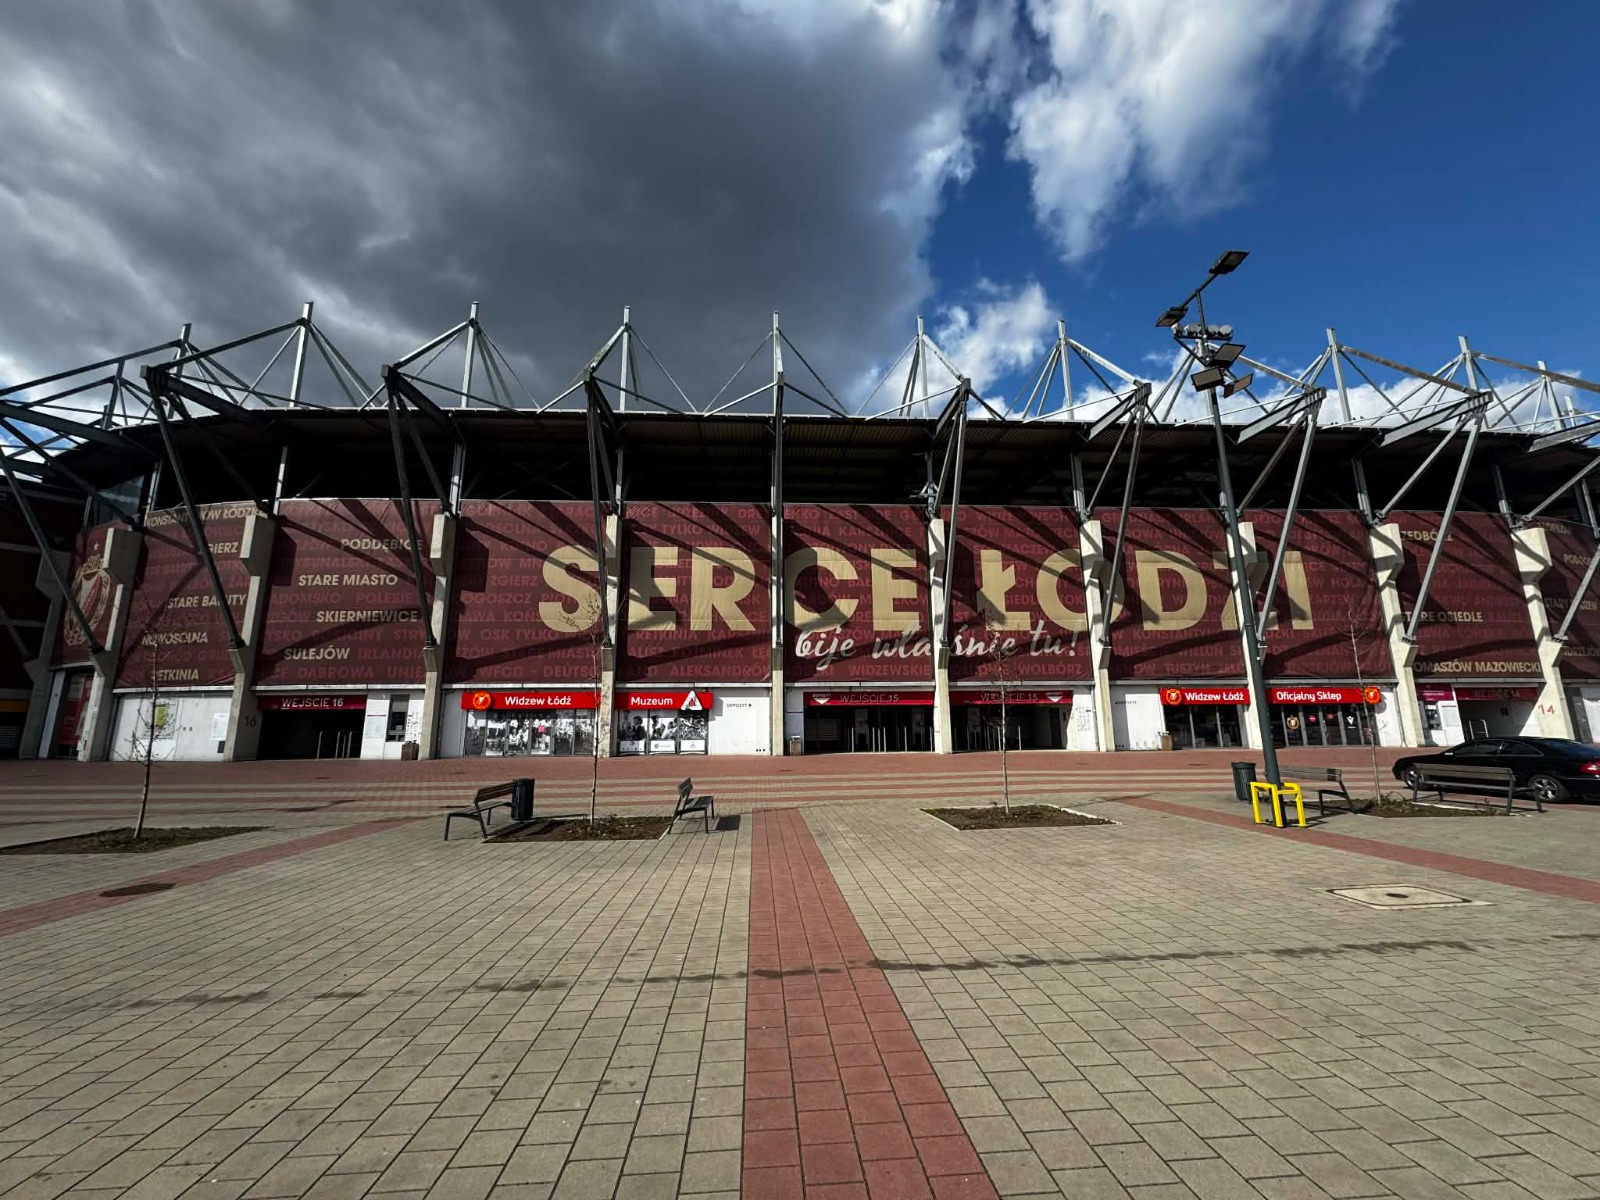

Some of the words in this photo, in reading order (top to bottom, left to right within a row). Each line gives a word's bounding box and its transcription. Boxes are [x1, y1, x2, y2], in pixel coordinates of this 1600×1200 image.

[297, 574, 340, 587] STARE
[342, 574, 399, 586] MIASTO
[490, 576, 538, 586] ZGIERZ
[539, 545, 919, 633] SERCE
[167, 595, 200, 609] STARE
[316, 610, 419, 623] SKIERNIEWICE
[1437, 610, 1483, 622] OSIEDLE
[480, 629, 510, 640] OSK
[284, 645, 350, 660] SULEJÓW
[795, 627, 856, 670] bije
[850, 665, 931, 677] WIDZEWSKIE
[1475, 661, 1540, 673] MAZOWIECKI
[297, 667, 375, 680] DĄBROWA
[505, 696, 545, 706] Widzew
[547, 695, 571, 706] Łódź
[631, 696, 673, 706] Muzeum
[840, 692, 885, 703] WEJŚCIE
[888, 694, 899, 703] 15
[1185, 692, 1221, 701] Widzew
[1222, 691, 1245, 701] Łódź
[1276, 690, 1315, 702] Oficjalny
[1317, 690, 1342, 702] Sklep
[282, 697, 330, 708] WEJŚCIE
[333, 698, 344, 707] 16
[1538, 703, 1556, 715] 14
[244, 716, 257, 728] 16
